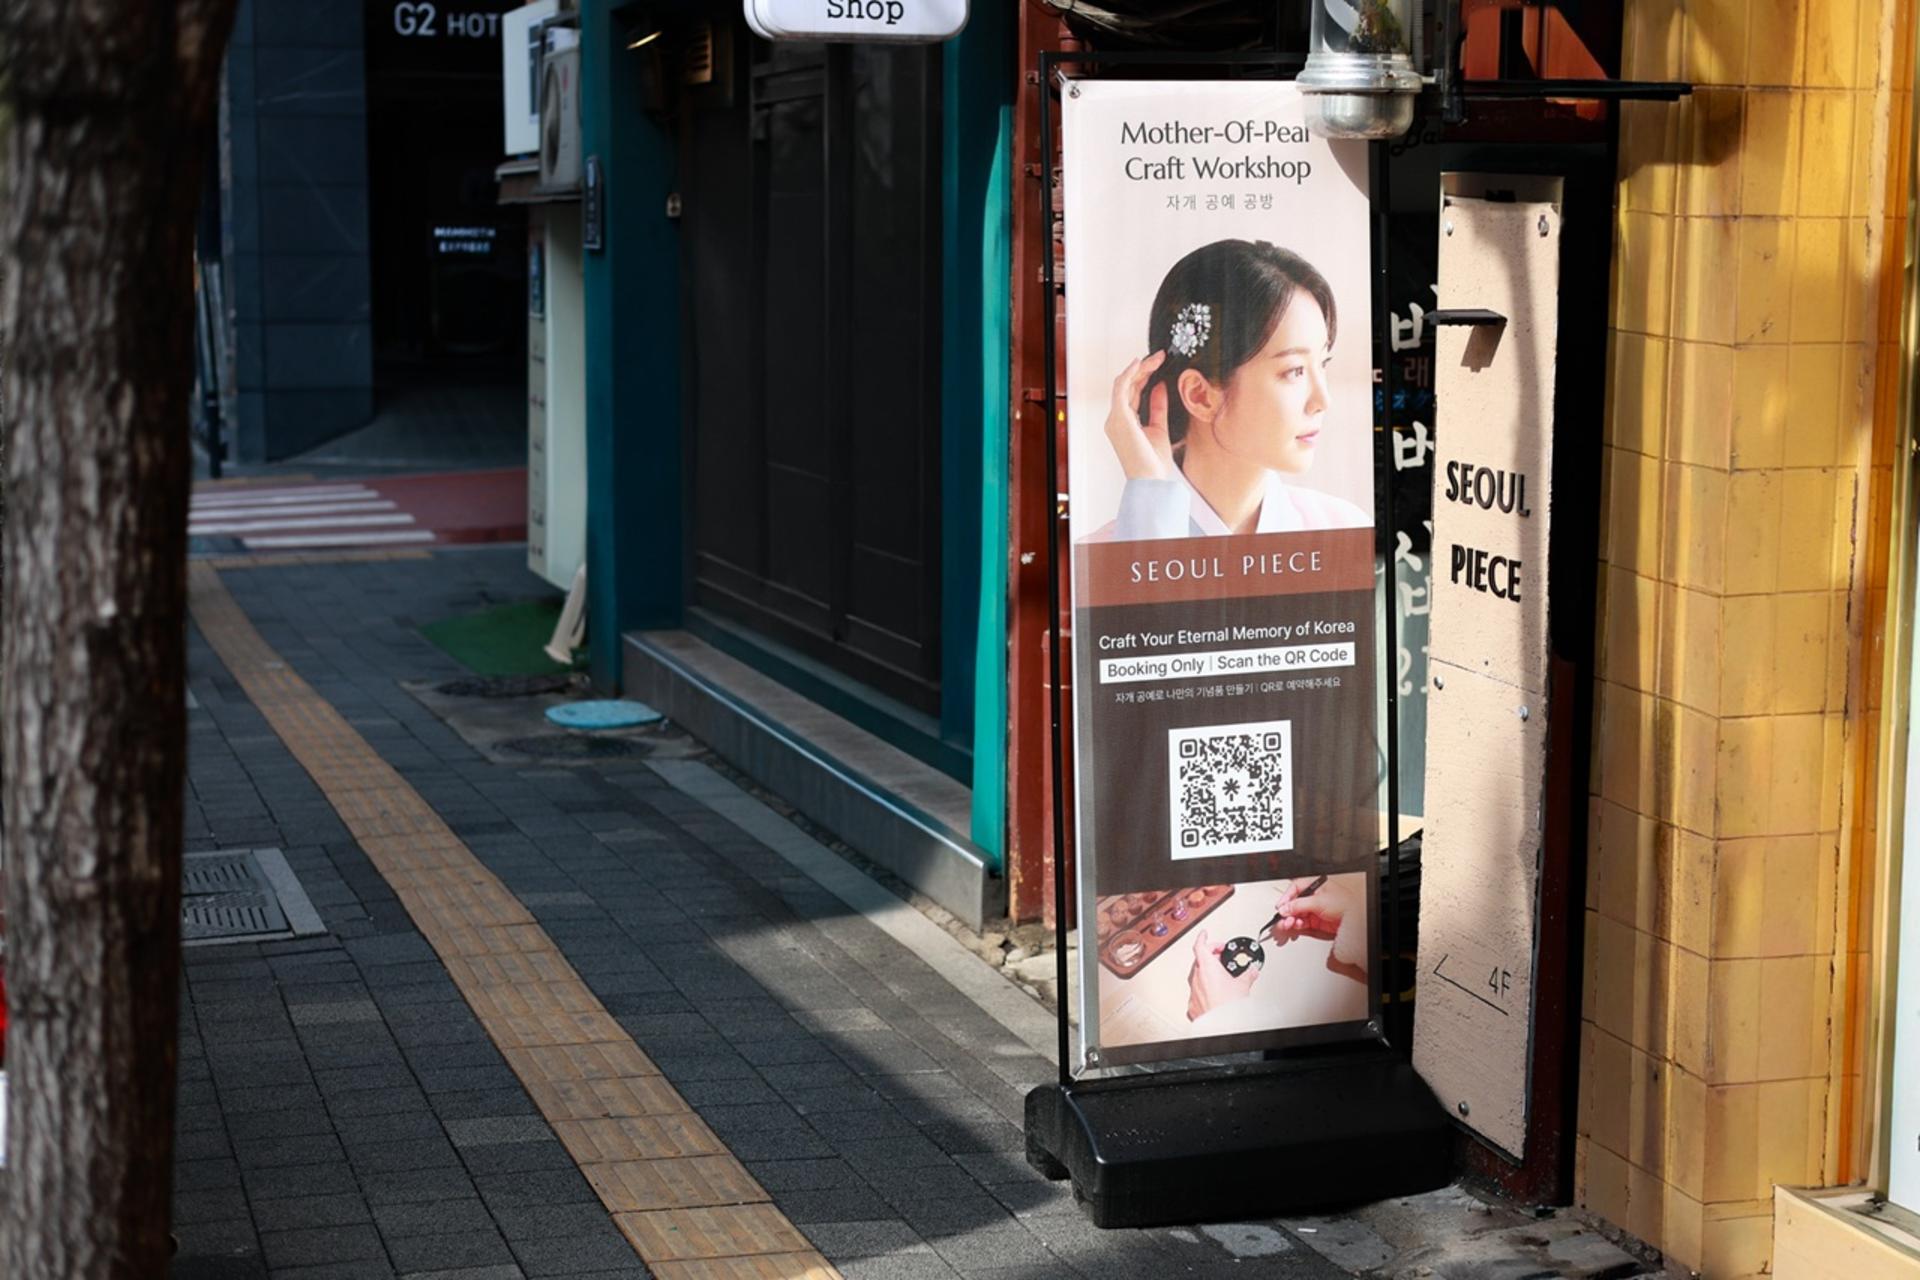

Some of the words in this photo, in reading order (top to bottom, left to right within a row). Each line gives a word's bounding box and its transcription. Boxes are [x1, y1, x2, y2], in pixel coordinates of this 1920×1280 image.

[394, 2, 436, 36] G2
[447, 13, 499, 37] HOT
[826, 0, 904, 24] Shop
[1125, 156, 1185, 180] Craft
[1193, 155, 1312, 185] Workshop
[1166, 194, 1197, 210] 자개
[1206, 193, 1236, 209] 공예
[1244, 192, 1274, 209] 공방
[1445, 460, 1531, 518] SEOUL
[1131, 557, 1224, 583] SEOUL
[1242, 551, 1323, 576] PIECE
[1451, 543, 1522, 603] PIECE
[1099, 633, 1137, 650] Craft
[1140, 631, 1172, 647] Your
[1178, 627, 1229, 645] Eternal
[1233, 623, 1292, 642] Memory
[1296, 622, 1310, 636] of
[1314, 619, 1355, 635] Korea
[1107, 661, 1167, 677] Booking
[1171, 658, 1204, 674] Only
[1217, 653, 1253, 669] Scan
[1258, 651, 1280, 666] the
[1284, 648, 1306, 664] QR
[1310, 646, 1348, 662] Code
[1115, 691, 1135, 704] 자개
[1136, 689, 1165, 703] 공예로
[1166, 687, 1194, 700] 나만의
[1196, 685, 1224, 697] 기념품
[1226, 682, 1254, 695] 만들기
[1260, 680, 1284, 693] QR로
[1286, 676, 1341, 691] 예약해주세요
[1488, 966, 1511, 998] 4F
